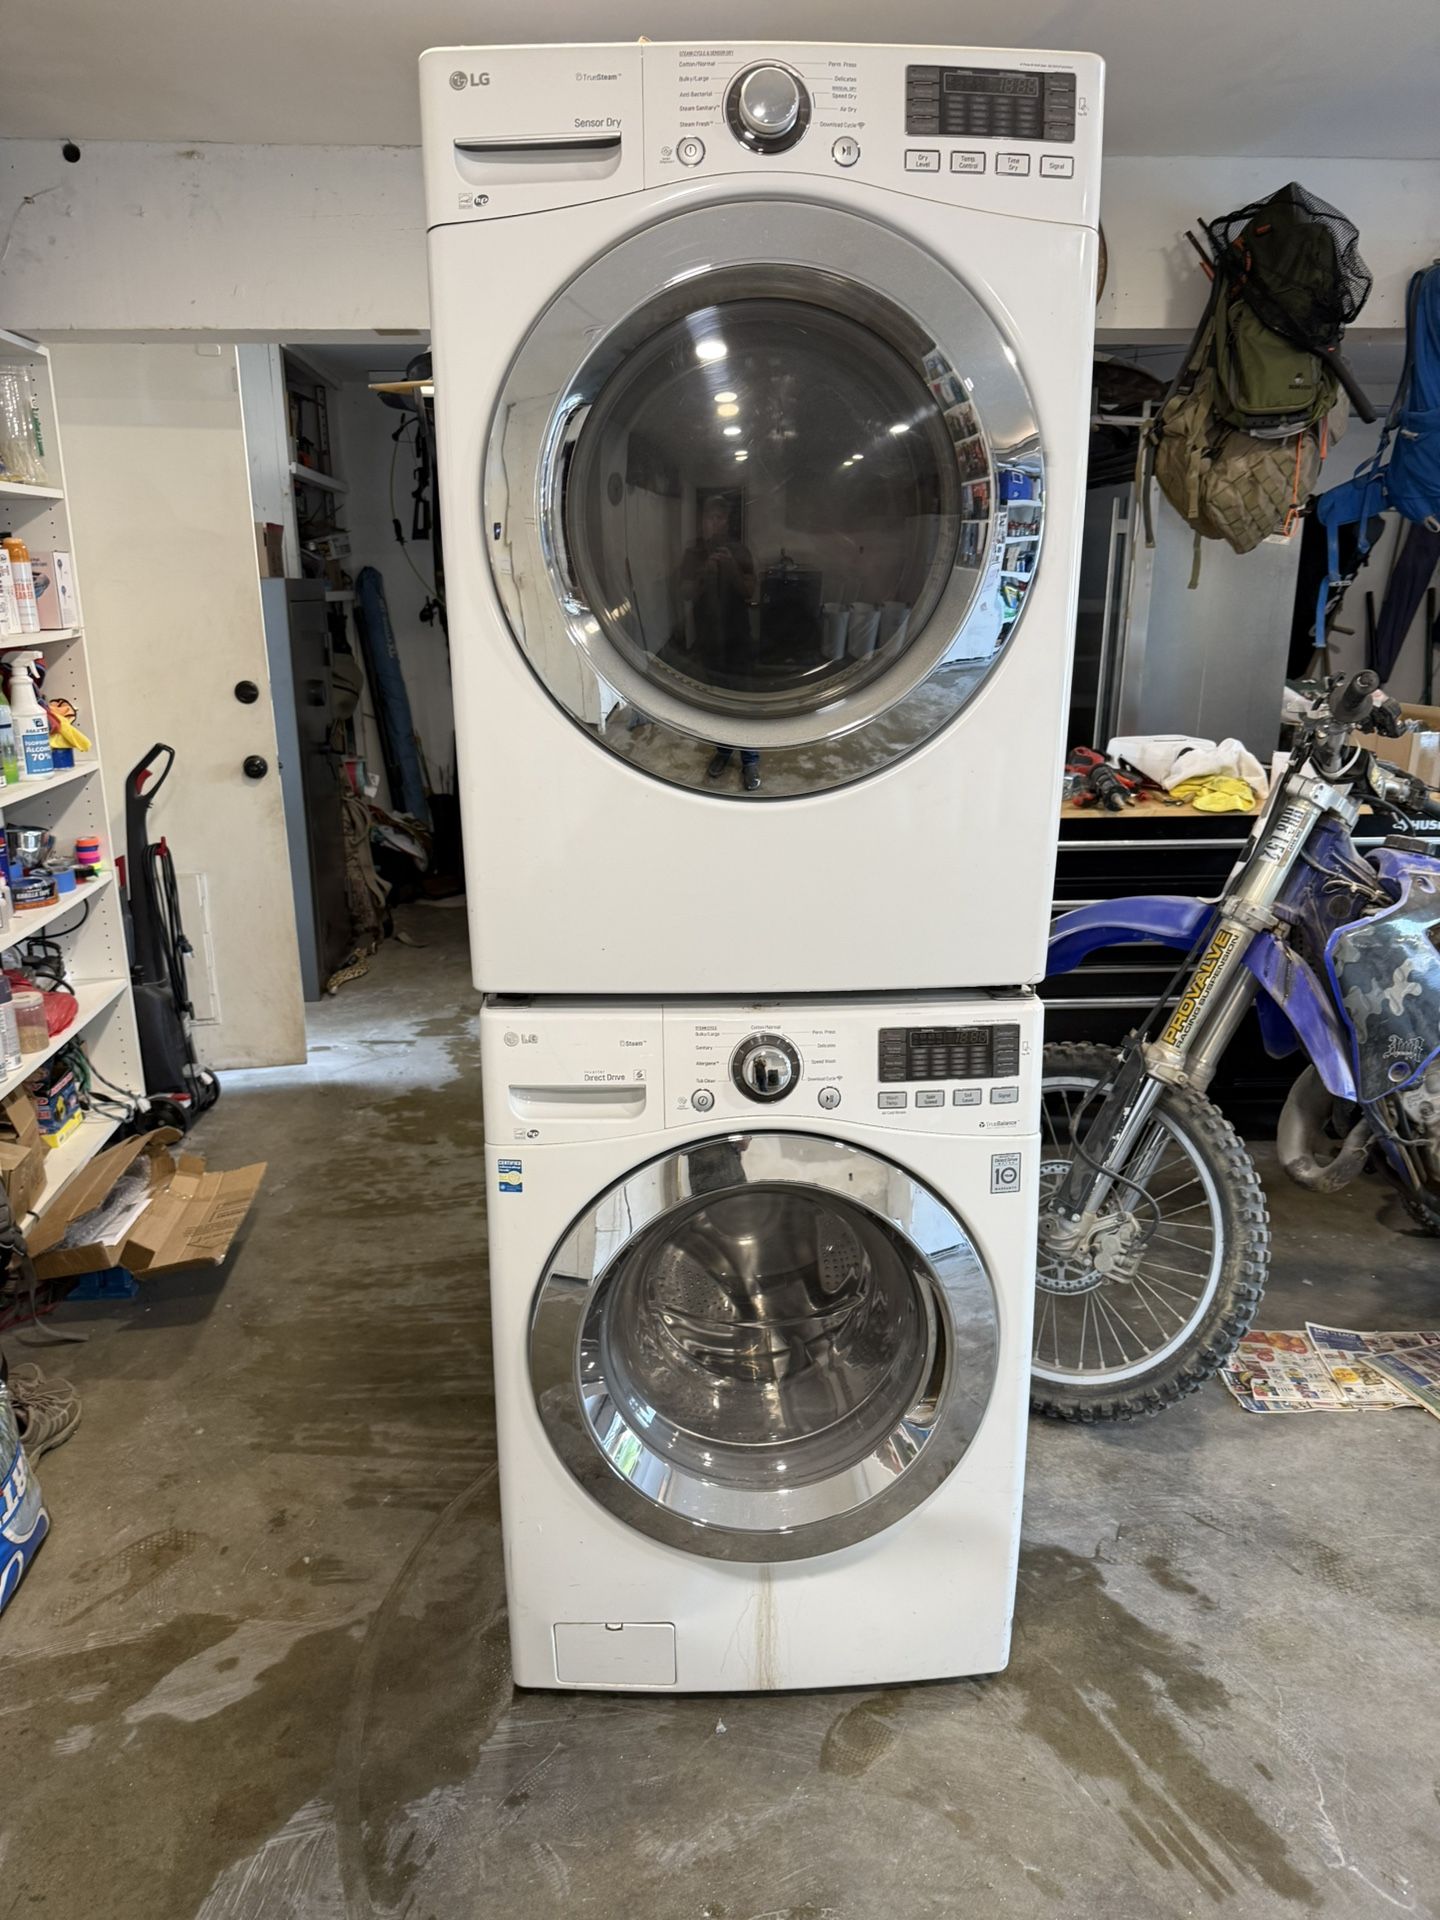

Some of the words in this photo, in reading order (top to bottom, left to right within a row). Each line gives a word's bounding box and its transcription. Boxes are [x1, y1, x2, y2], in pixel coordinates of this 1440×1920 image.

[470, 73, 490, 87] LG
[574, 118, 604, 128] Sensor
[606, 117, 622, 129] Dry
[1049, 162, 1065, 170] Signal
[1411, 820, 1440, 830] HUS
[1162, 928, 1234, 1046] PROVALVE
[1175, 1007, 1201, 1049] RACING
[1198, 934, 1239, 1006] SUSPENSION
[521, 1034, 538, 1044] LG
[584, 1074, 606, 1082] Direct
[606, 1073, 625, 1081] Drive
[994, 1166, 1017, 1185] 10
